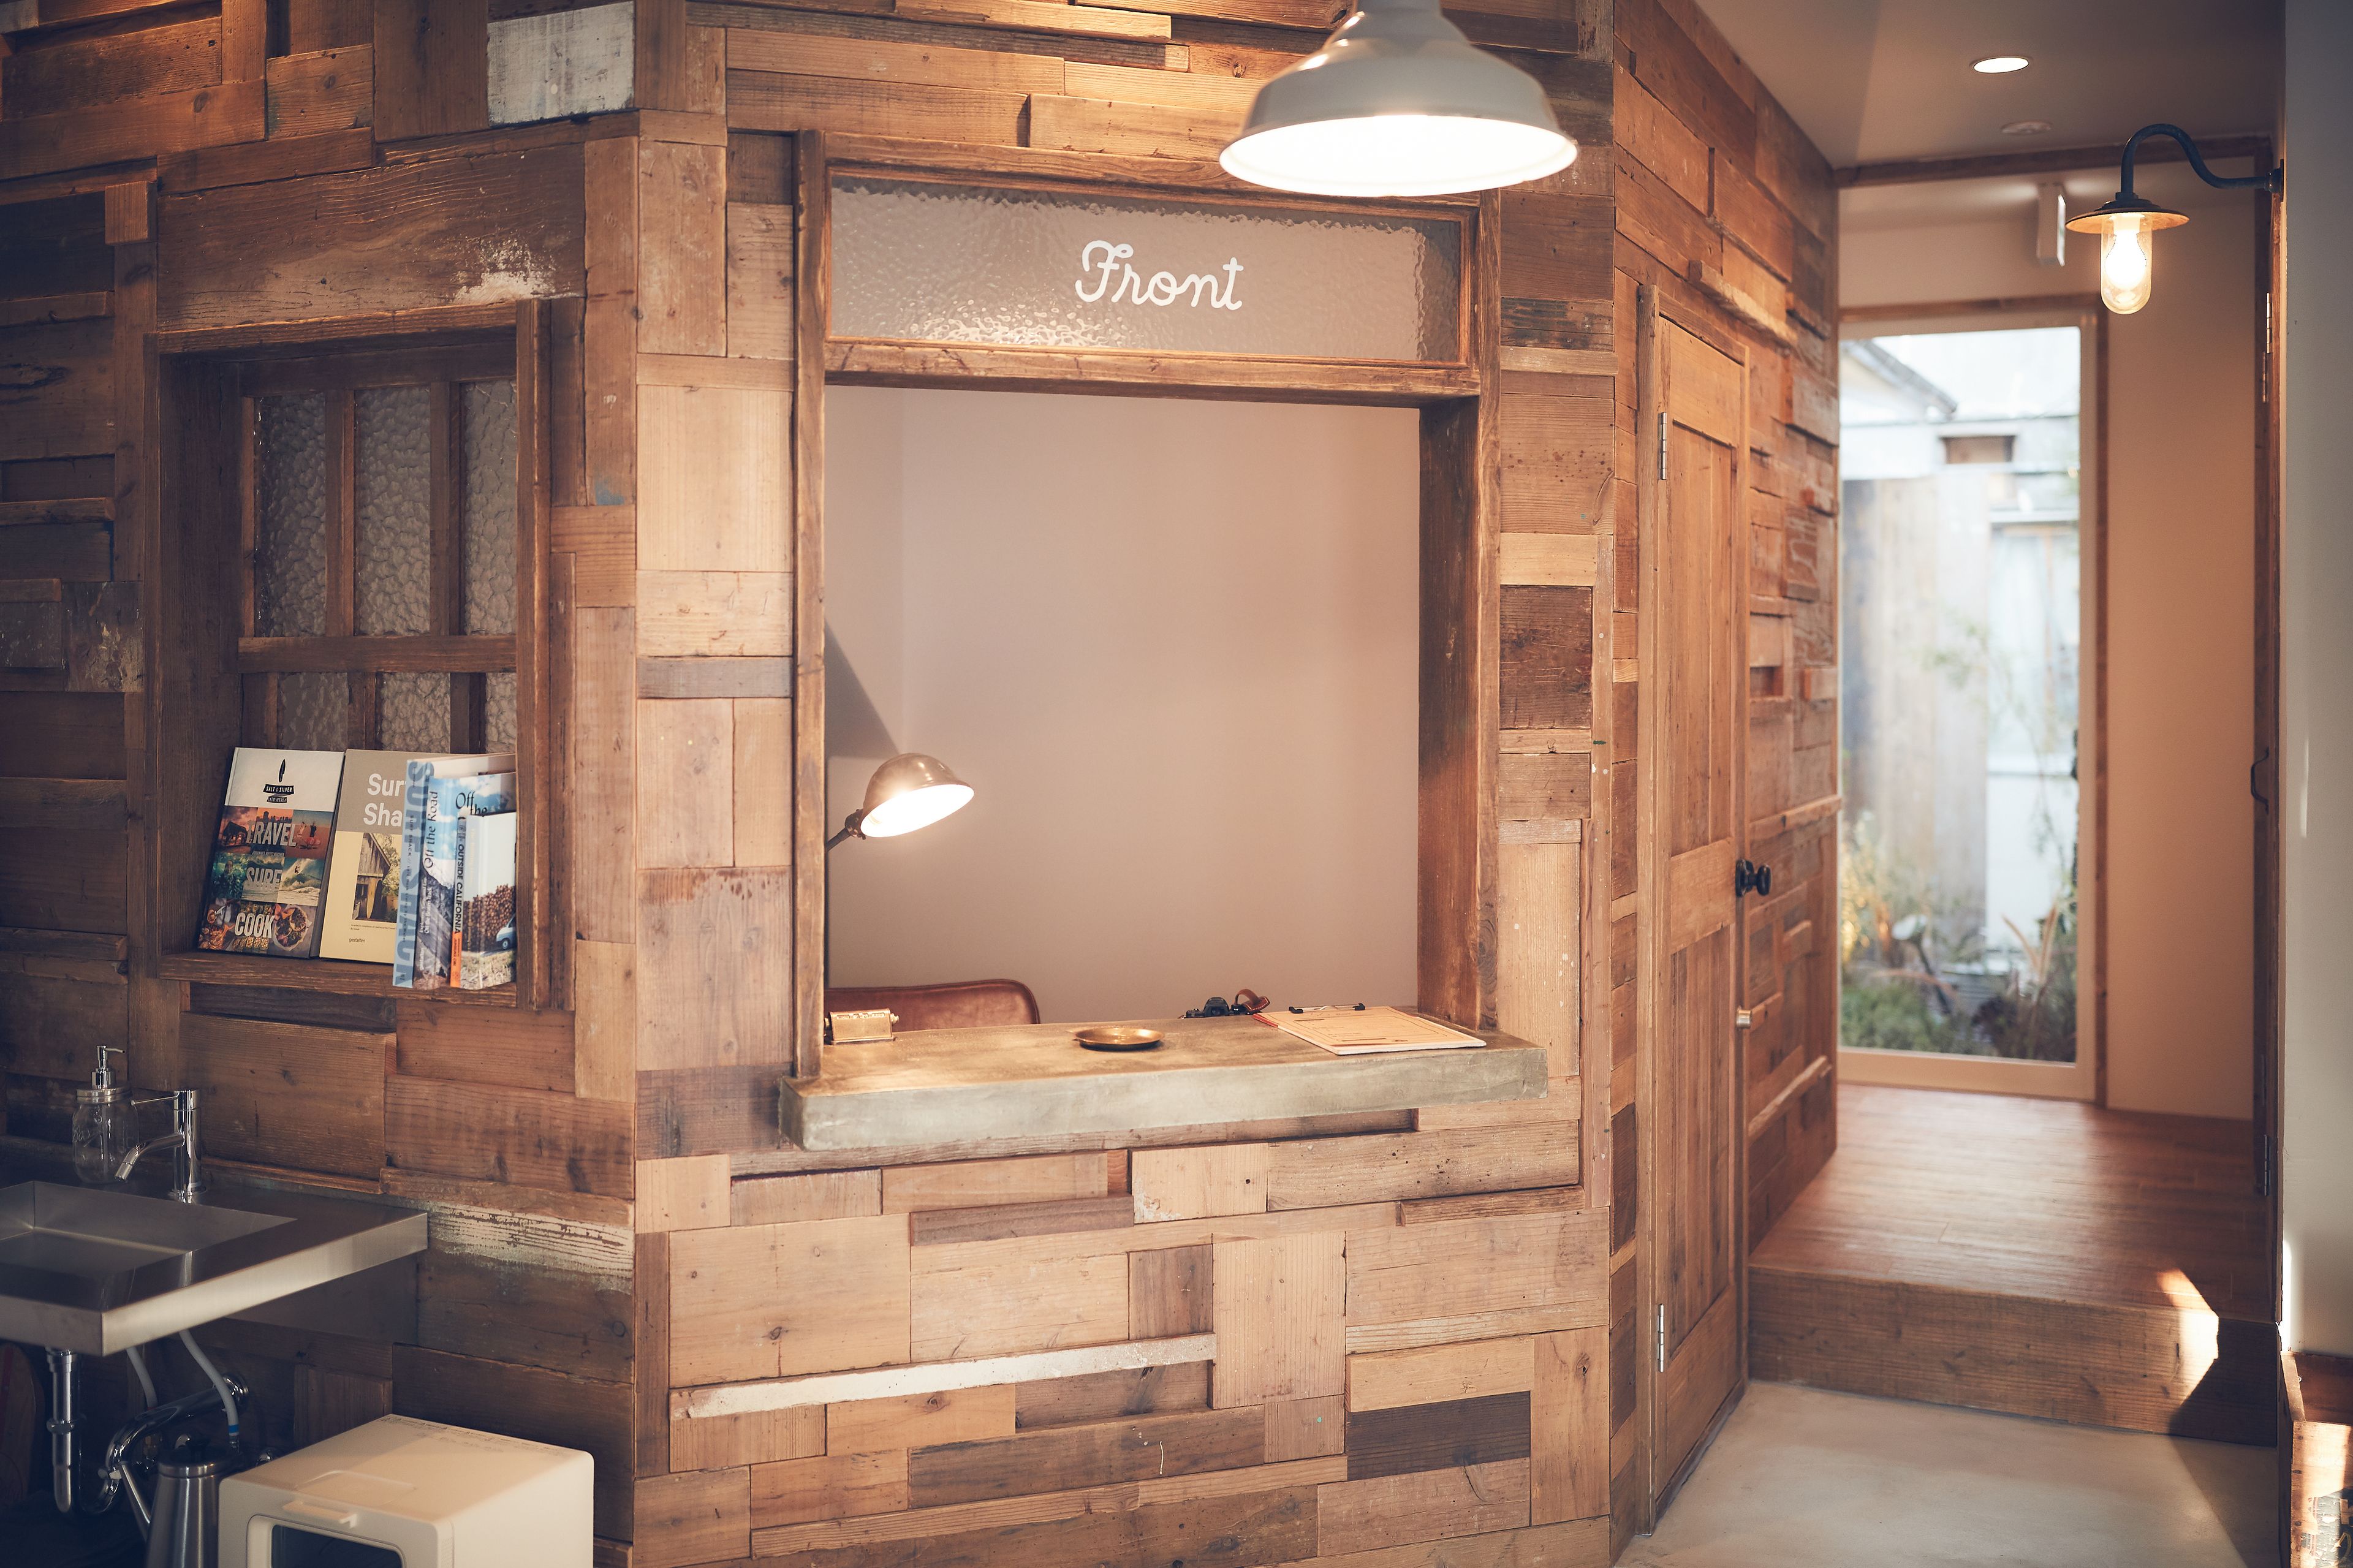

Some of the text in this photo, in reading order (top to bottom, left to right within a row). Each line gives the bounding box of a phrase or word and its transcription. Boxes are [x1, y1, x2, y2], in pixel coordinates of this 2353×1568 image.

[1075, 240, 1244, 310] Front
[368, 773, 406, 797] Sur
[455, 790, 476, 809] Off
[404, 761, 434, 852] SURF
[246, 820, 297, 847] TRAVEL
[423, 792, 438, 869] Off the Road
[235, 912, 275, 938] COOK
[454, 882, 463, 934] CALIFORNIA
